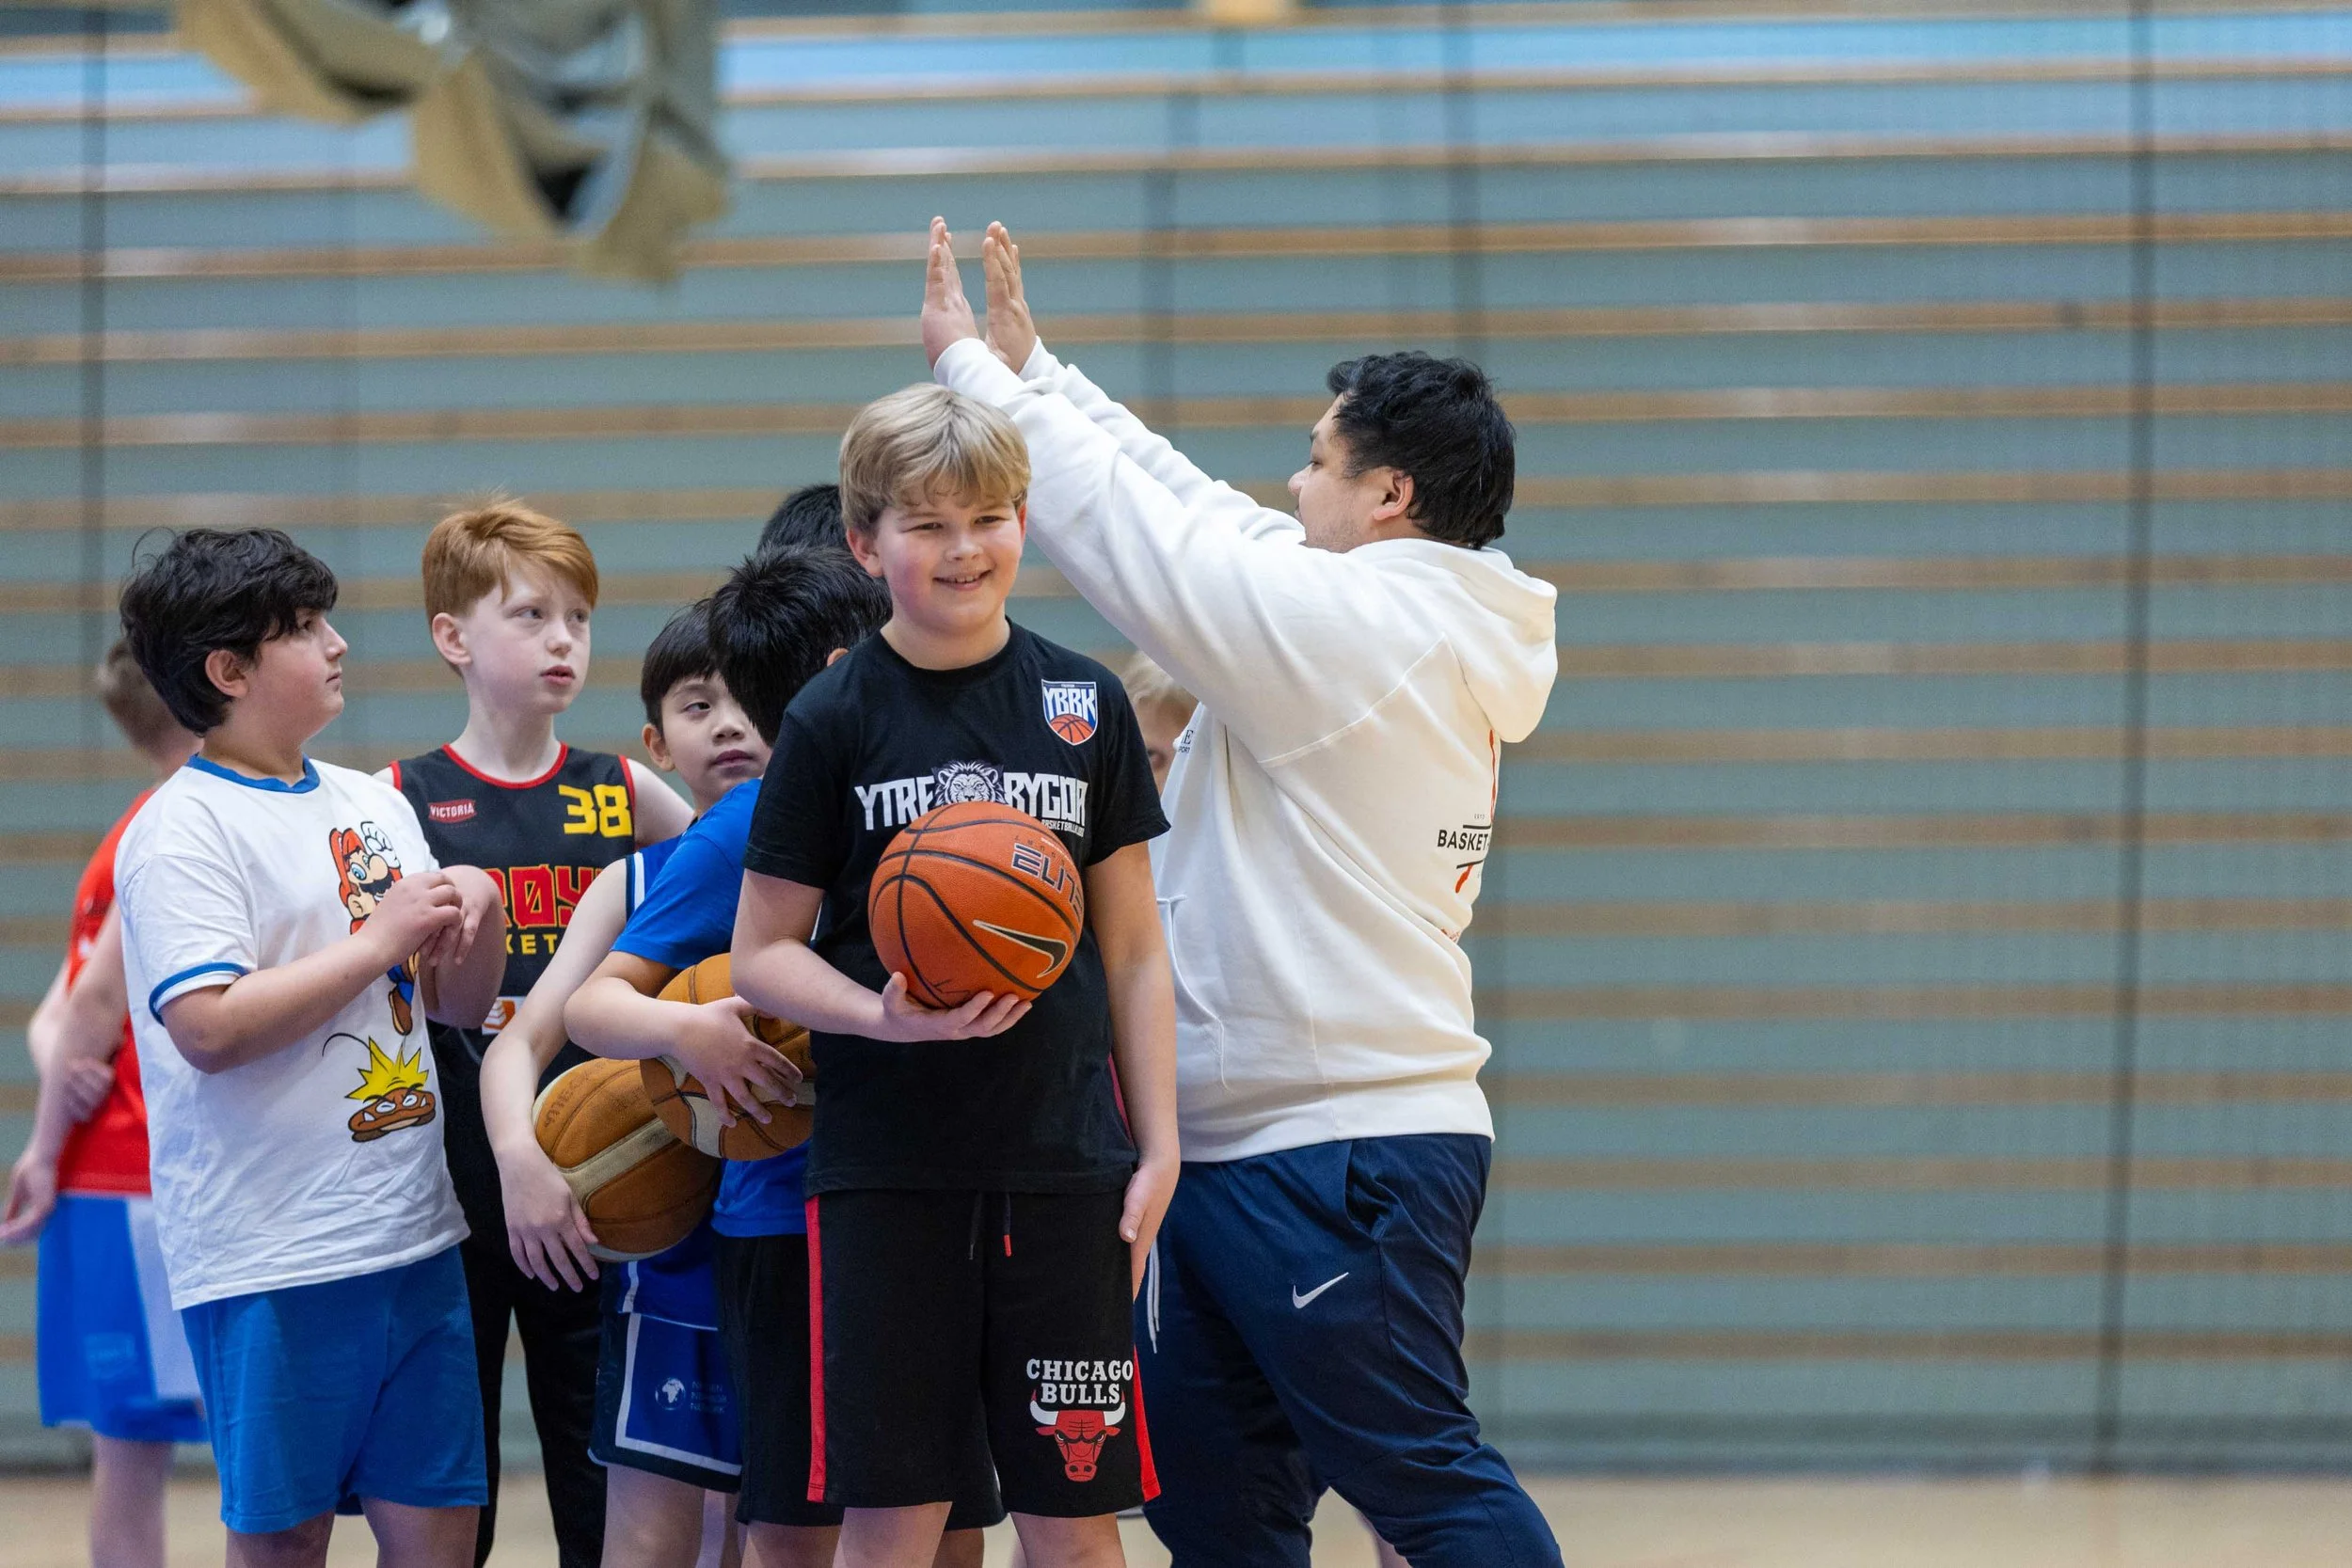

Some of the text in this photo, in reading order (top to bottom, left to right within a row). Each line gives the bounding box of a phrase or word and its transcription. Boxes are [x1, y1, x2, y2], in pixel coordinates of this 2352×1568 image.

[1043, 687, 1096, 721] YBBK
[429, 801, 475, 819] VICTORIA
[558, 784, 633, 837] 38
[1025, 1358, 1134, 1381] CHICAGO
[1041, 1383, 1120, 1404] BULLS
